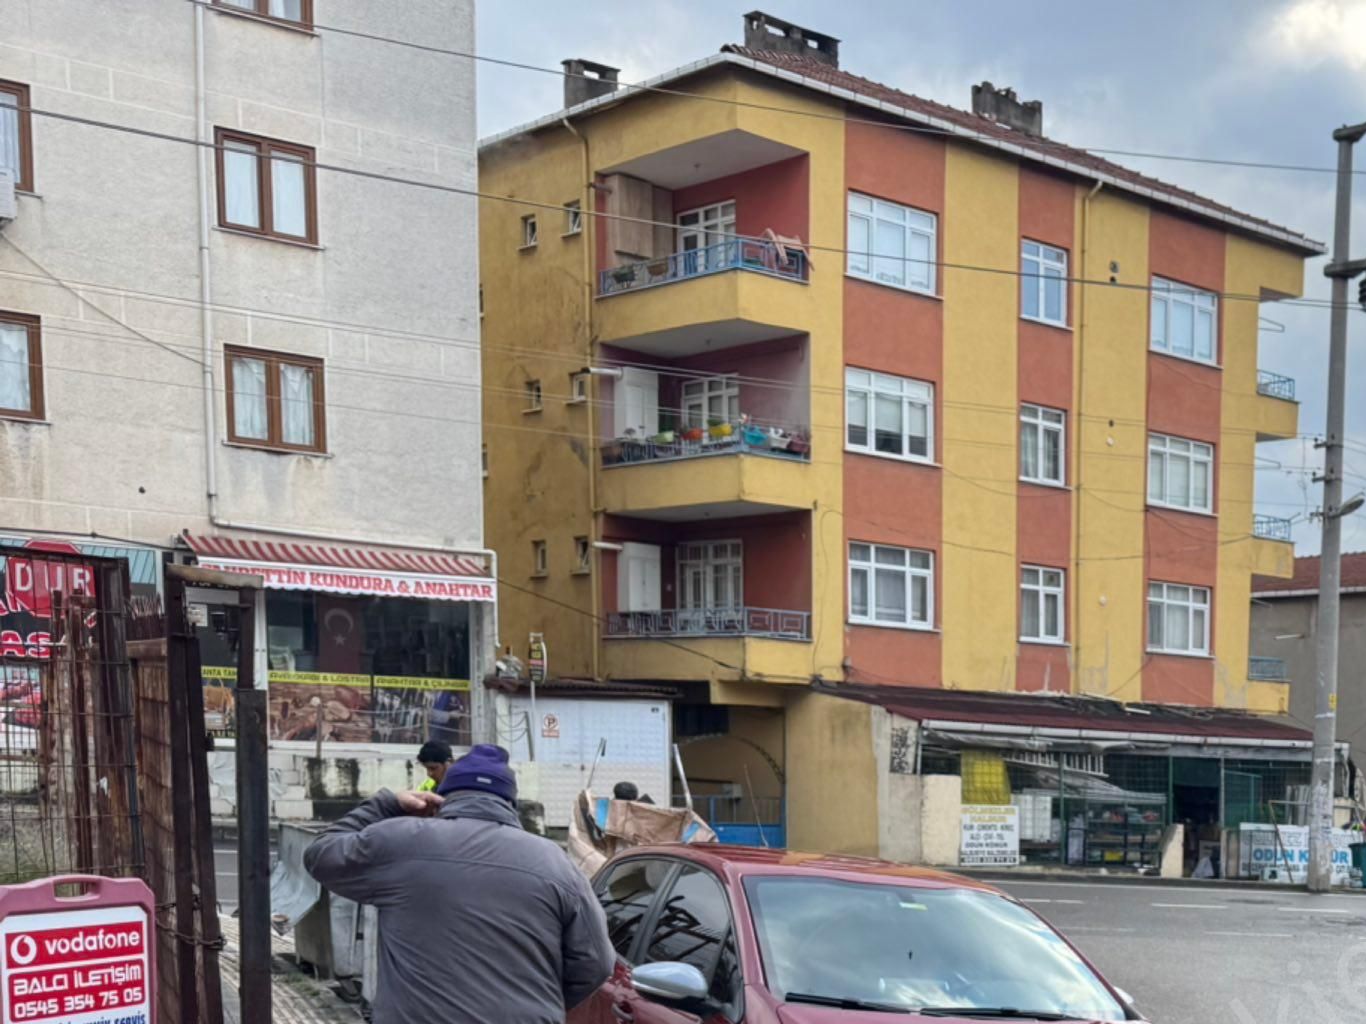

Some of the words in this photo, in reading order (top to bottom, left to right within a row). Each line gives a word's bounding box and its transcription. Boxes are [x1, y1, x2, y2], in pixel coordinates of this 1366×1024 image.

[14, 562, 91, 598] DUR
[310, 573, 395, 593] KUNDURA
[396, 582, 410, 594] &
[413, 580, 494, 598] ANAHTAR
[1253, 848, 1295, 862] ODUN
[44, 929, 141, 956] vodafone
[14, 998, 59, 1019] 0545
[64, 995, 95, 1012] 354
[99, 990, 119, 1007] 75
[123, 987, 143, 1003] 05
